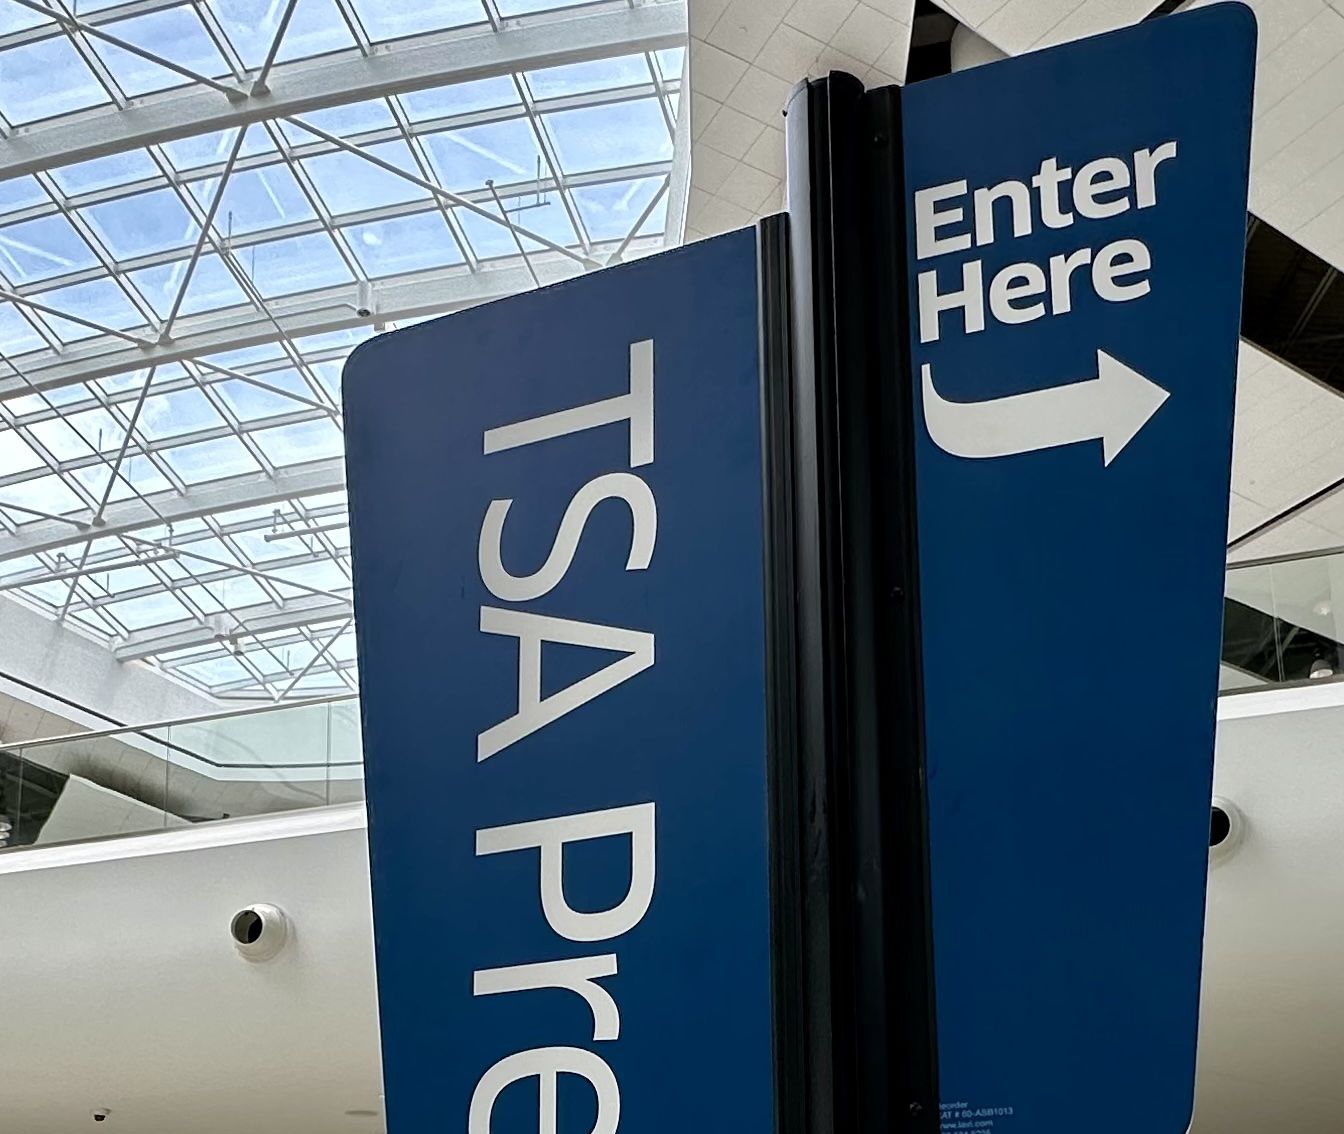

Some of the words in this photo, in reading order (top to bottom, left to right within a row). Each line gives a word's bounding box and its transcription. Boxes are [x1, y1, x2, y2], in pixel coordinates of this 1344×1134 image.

[915, 141, 1177, 260] Enter
[918, 239, 1151, 343] Here
[477, 338, 657, 762] TSA
